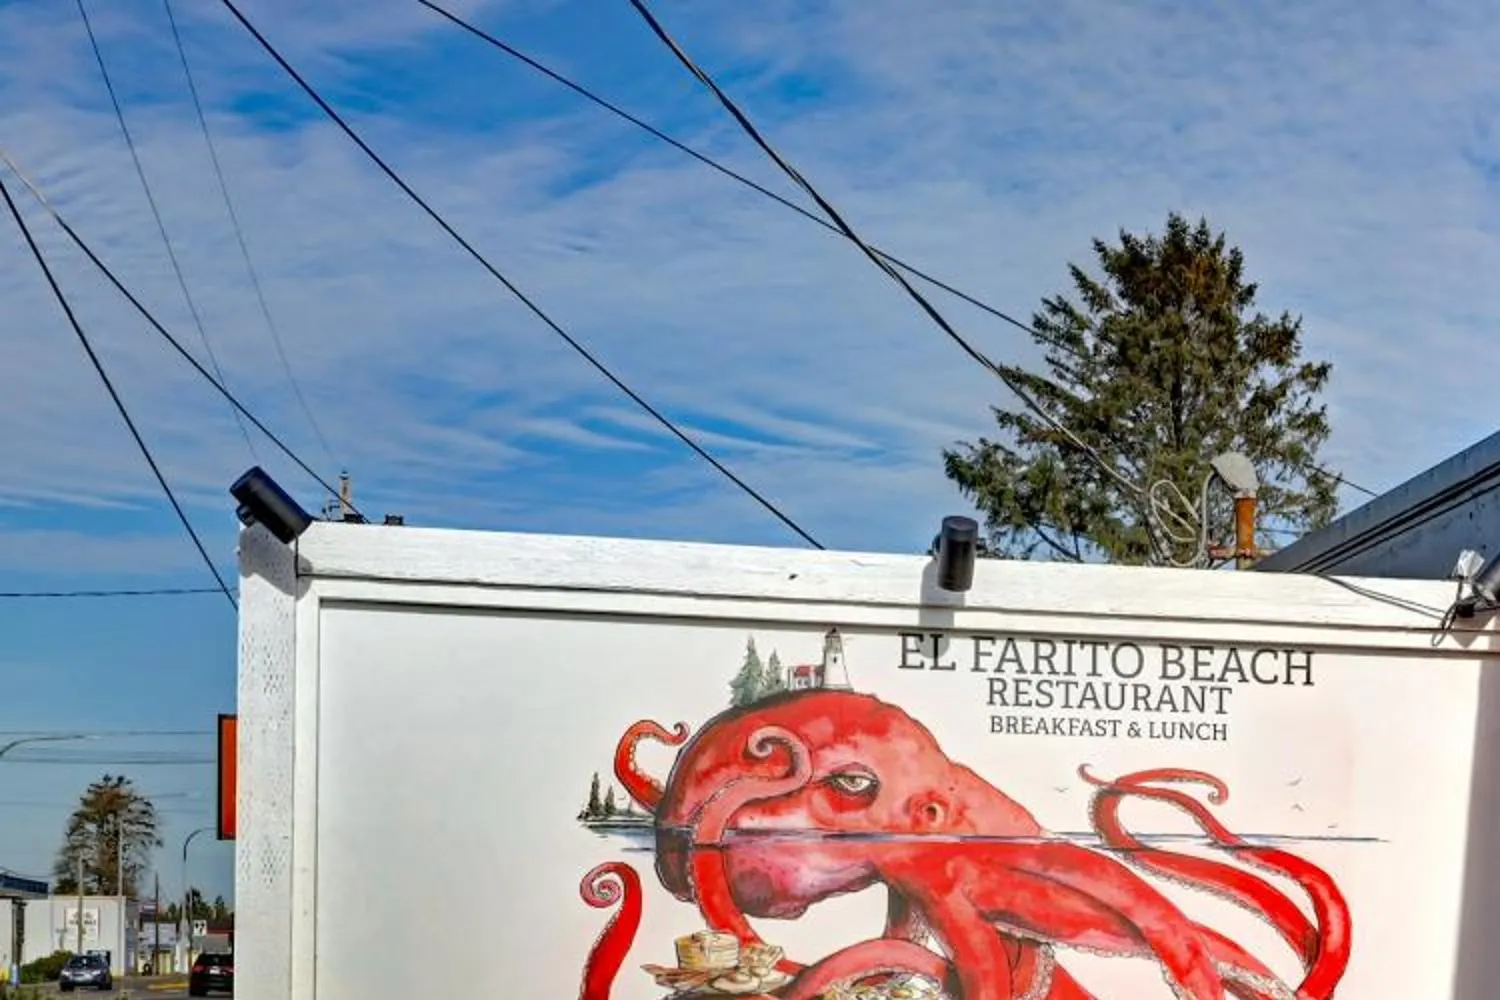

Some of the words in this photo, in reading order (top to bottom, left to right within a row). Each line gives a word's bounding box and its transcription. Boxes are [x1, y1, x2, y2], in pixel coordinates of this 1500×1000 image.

[897, 632, 956, 671] EL
[970, 635, 1144, 679] FARITO
[1159, 644, 1316, 686] BEACH
[986, 677, 1233, 715] RESTAURANT
[990, 715, 1122, 738] BREAKFAST
[1127, 721, 1141, 738] &
[1149, 721, 1228, 741] LUNCH
